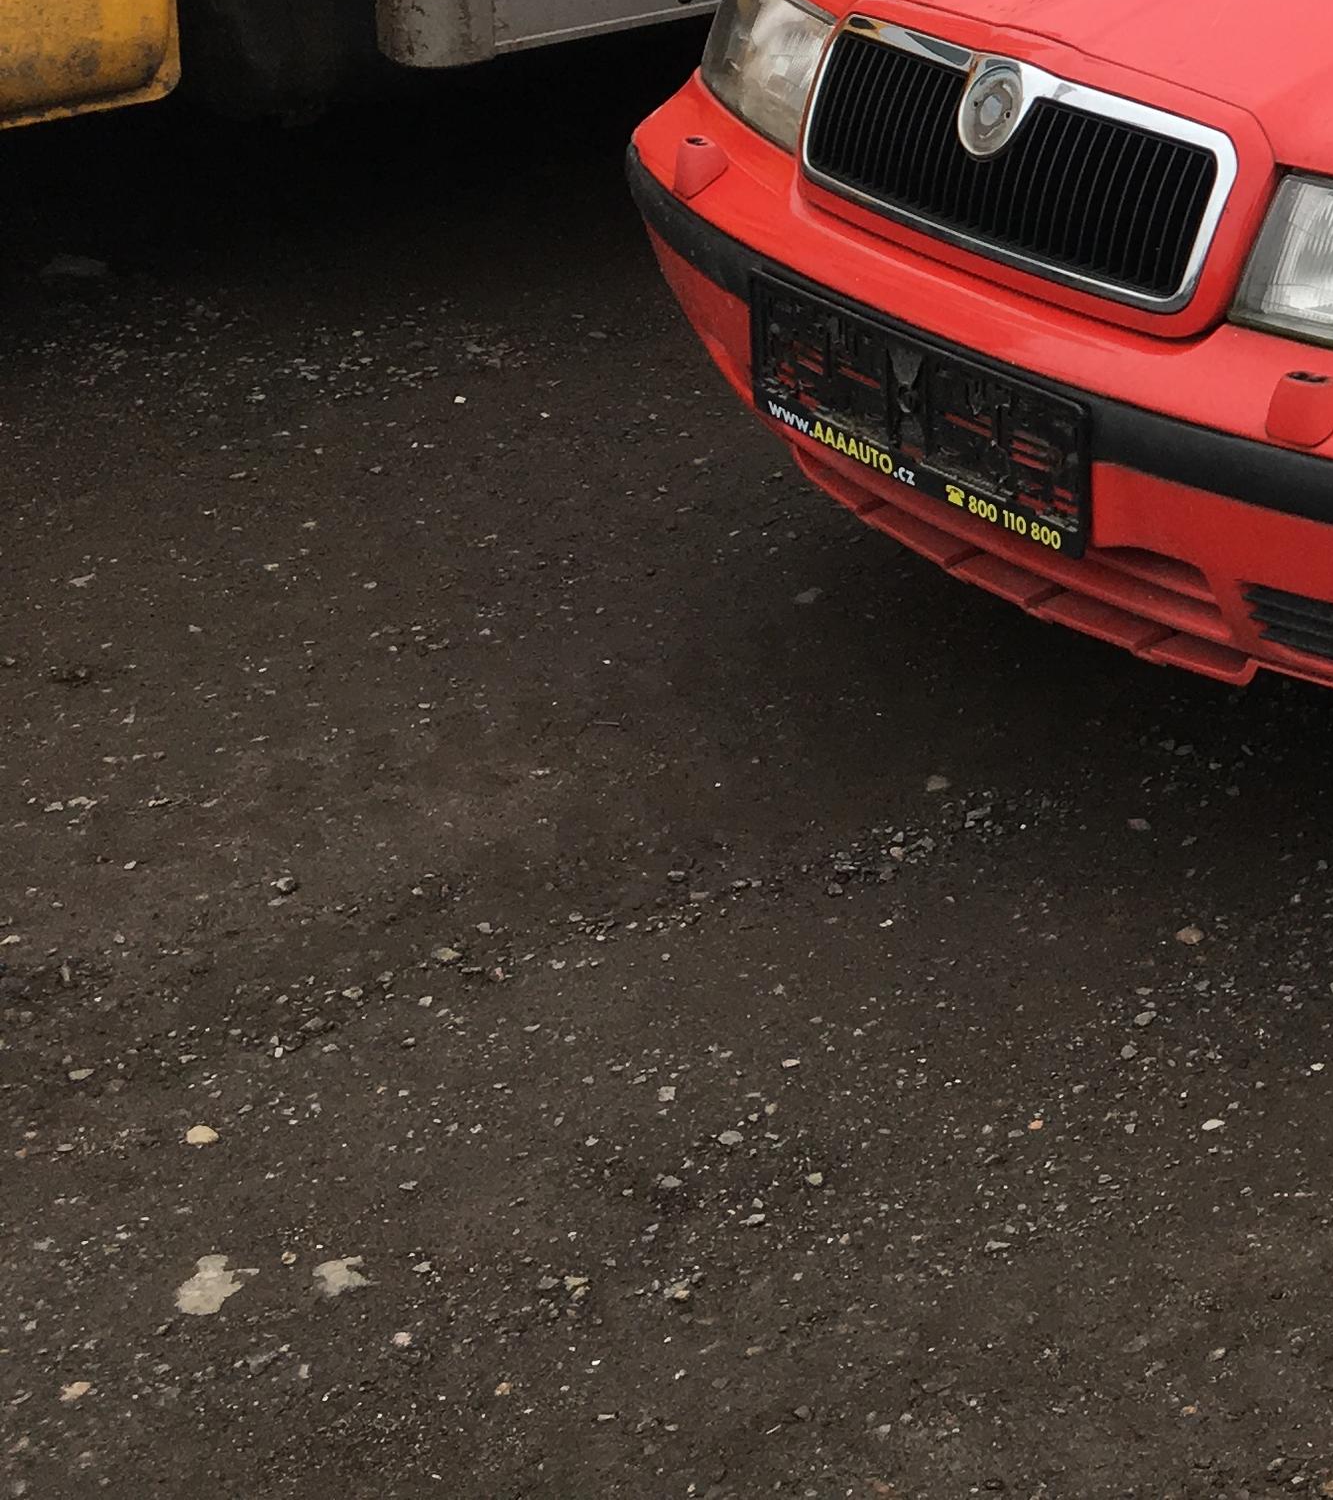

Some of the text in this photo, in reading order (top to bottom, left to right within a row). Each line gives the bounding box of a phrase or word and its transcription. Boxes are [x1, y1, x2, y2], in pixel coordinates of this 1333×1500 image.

[766, 399, 917, 487] www.AAAAUTO.cz
[967, 495, 1062, 551] 800 110 800
